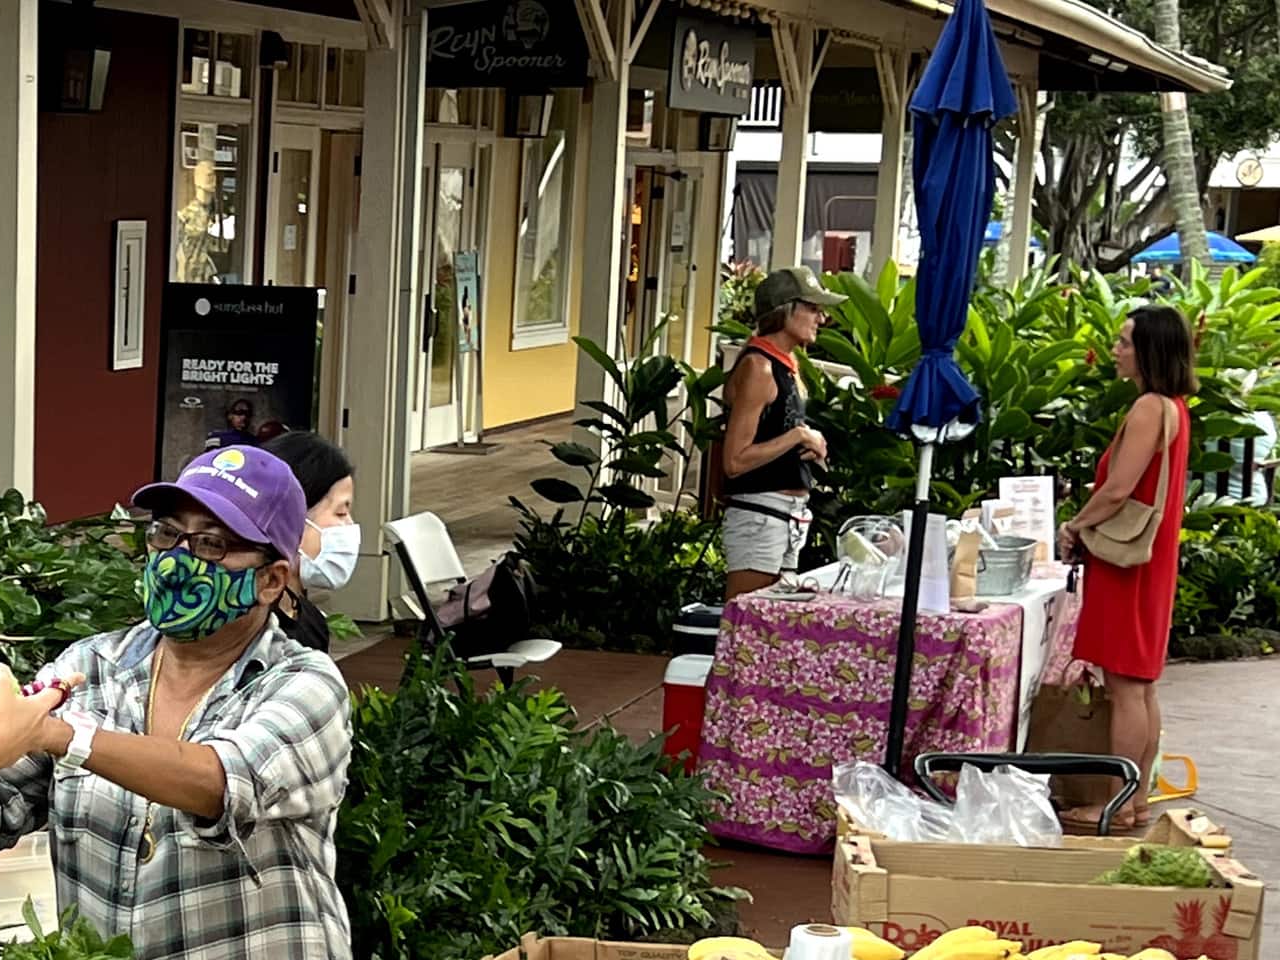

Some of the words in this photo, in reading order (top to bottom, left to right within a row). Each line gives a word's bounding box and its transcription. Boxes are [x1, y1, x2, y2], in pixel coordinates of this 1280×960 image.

[474, 46, 566, 75] Spooner
[213, 300, 262, 314] sunglass
[264, 301, 284, 314] hut
[182, 358, 224, 372] READY
[226, 360, 252, 373] FOR
[254, 362, 279, 374] THE
[181, 370, 228, 383] BRIGHT
[230, 372, 274, 386] LIGHTS
[882, 921, 943, 950] Dole
[640, 950, 684, 959] QUALITY
